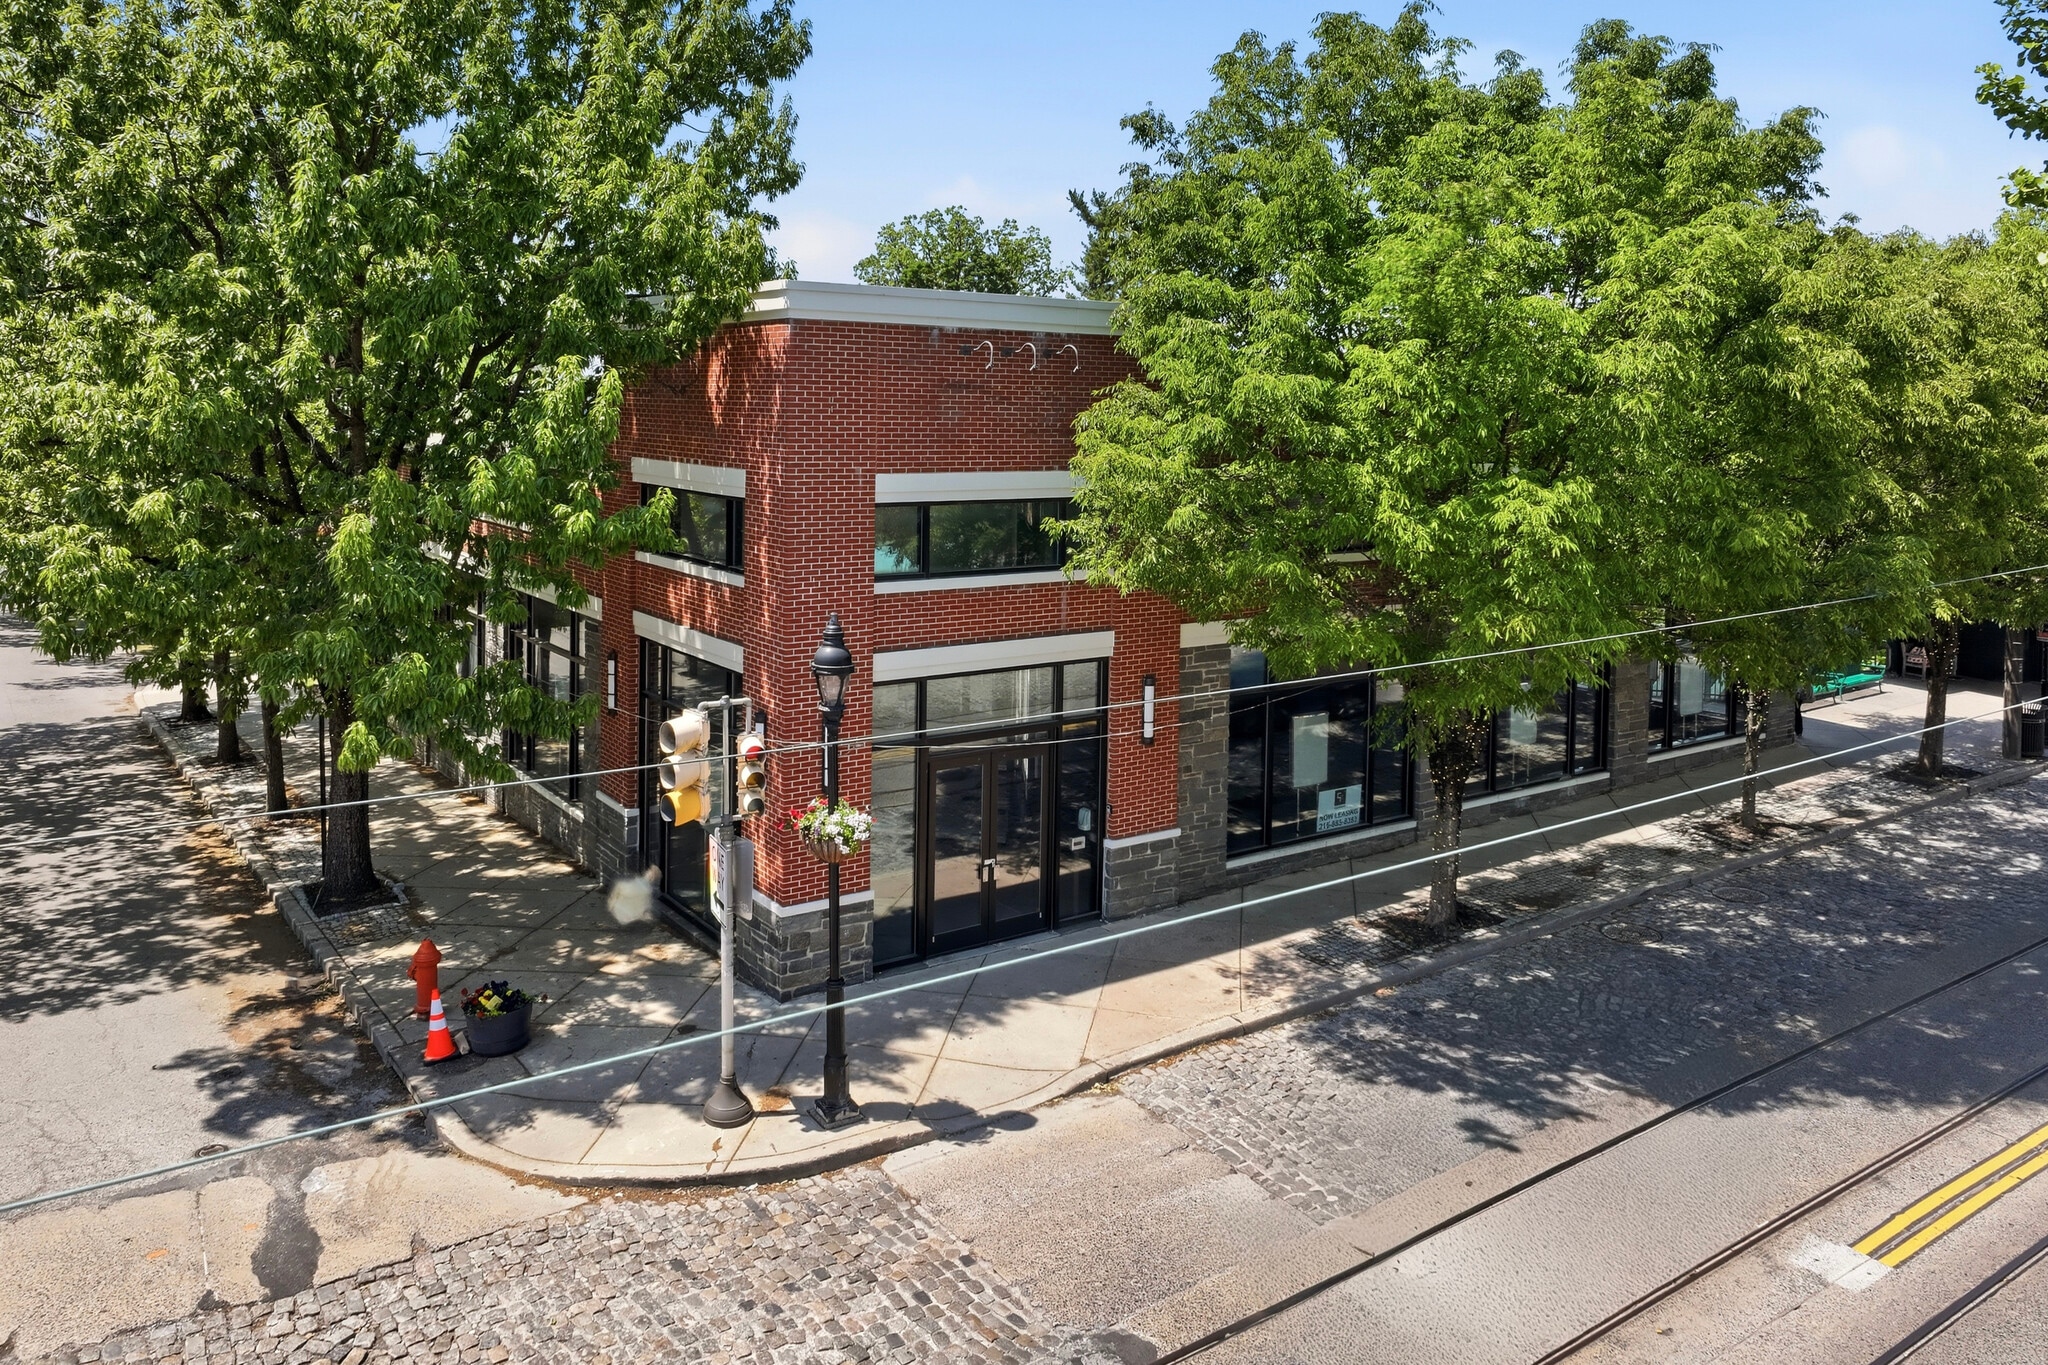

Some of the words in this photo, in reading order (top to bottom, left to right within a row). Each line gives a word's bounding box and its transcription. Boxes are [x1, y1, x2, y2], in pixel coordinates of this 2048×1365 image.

[1319, 813, 1334, 821] NOW
[1334, 808, 1358, 818] LEASING
[711, 845, 725, 871] ONE
